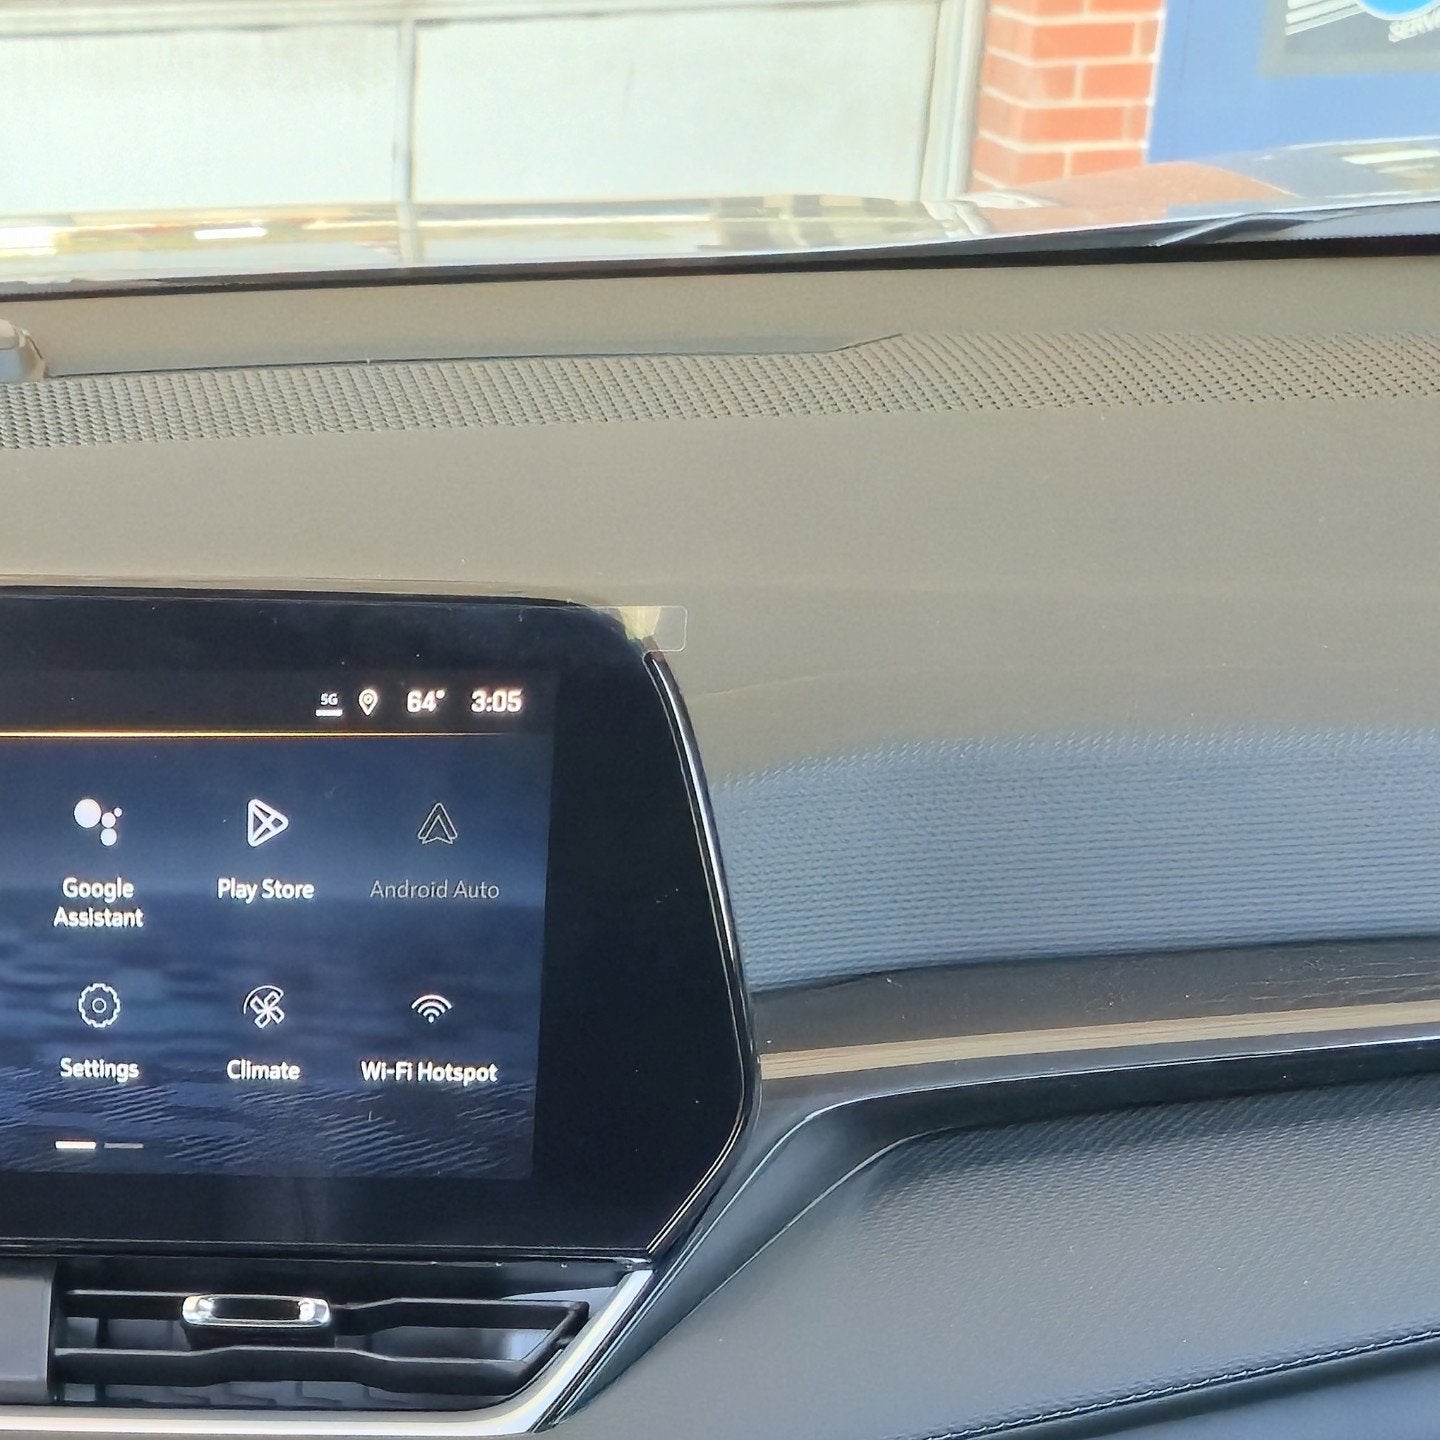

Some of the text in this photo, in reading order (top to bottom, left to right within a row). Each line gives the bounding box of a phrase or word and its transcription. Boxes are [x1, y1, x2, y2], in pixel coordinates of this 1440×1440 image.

[320, 689, 522, 713] 5G 64° 3:05
[62, 877, 134, 903] Google
[218, 877, 314, 903] Play Store
[369, 879, 499, 900] Android Auto
[53, 906, 144, 929] Assistant
[60, 1057, 139, 1082] Settings
[226, 1059, 301, 1080] Climate
[360, 1060, 498, 1087] Wi-Fi Hotspot
